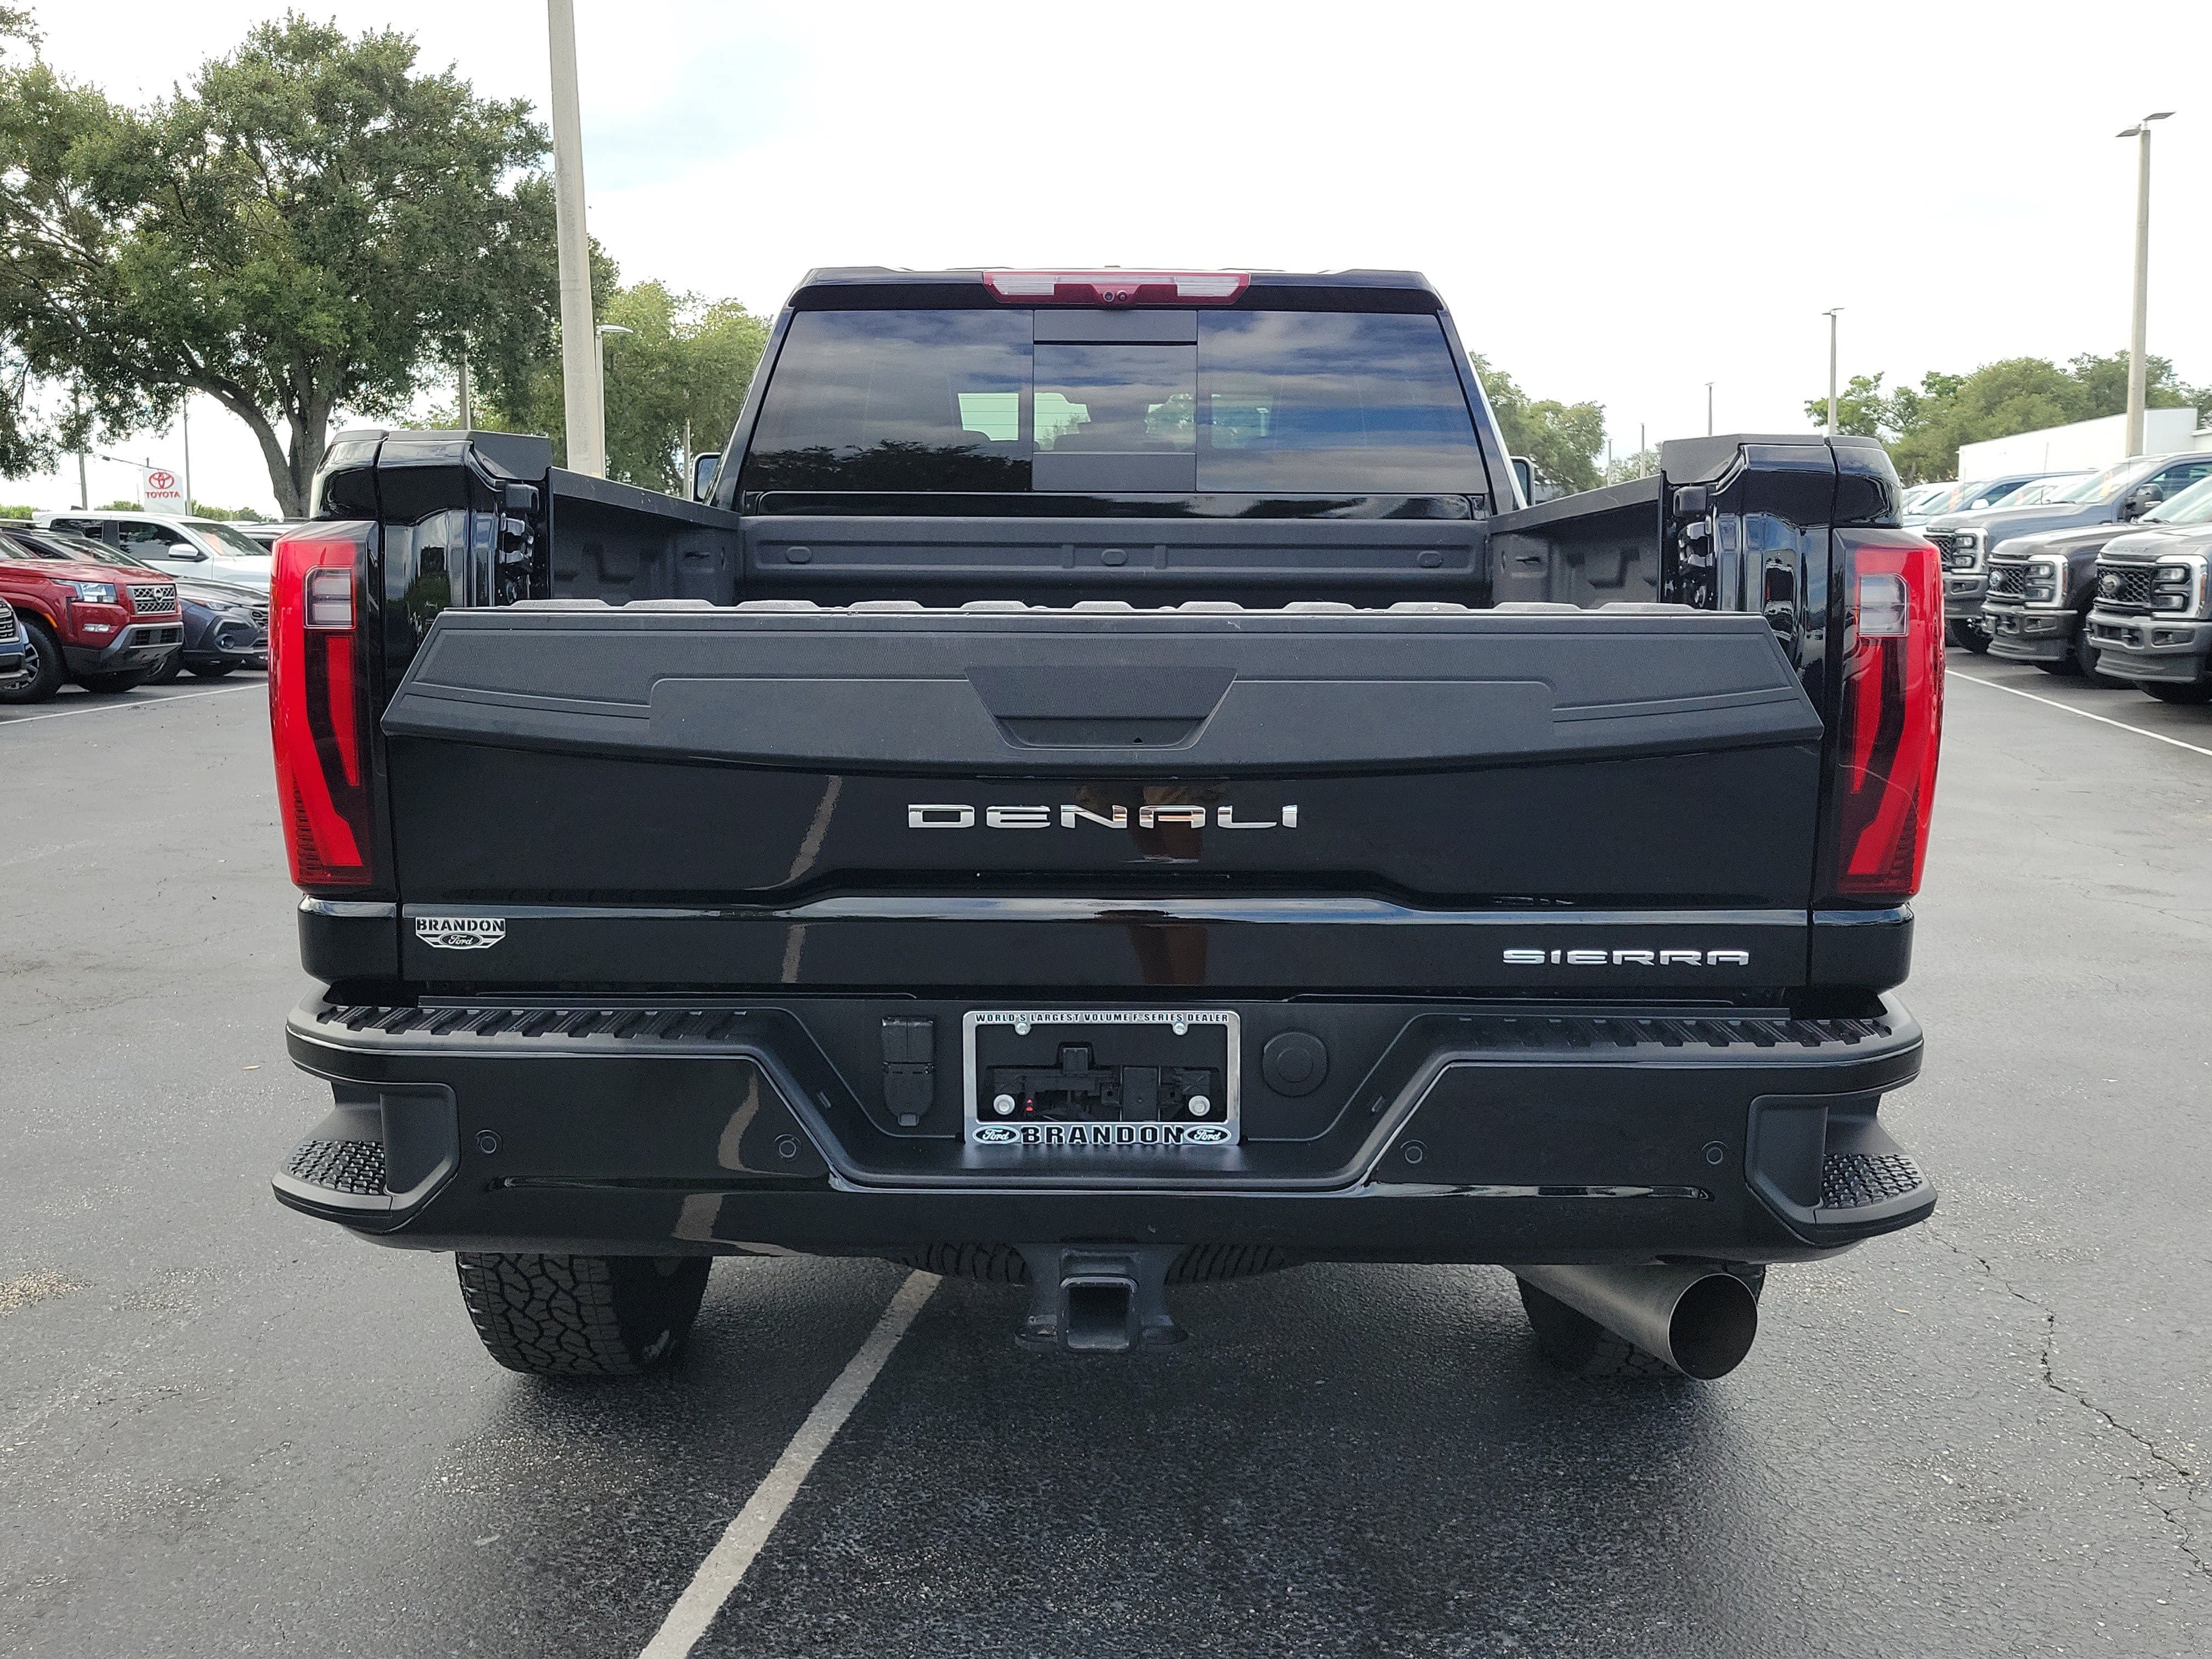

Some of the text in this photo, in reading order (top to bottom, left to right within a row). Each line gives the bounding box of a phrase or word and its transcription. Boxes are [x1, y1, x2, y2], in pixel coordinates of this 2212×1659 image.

[909, 804, 1297, 829] DENALI
[416, 918, 505, 932] BRANDON
[448, 935, 474, 945] Ford
[1503, 949, 1750, 966] SIERRA
[975, 1013, 1228, 1022] WORLD'S LARGEST VOLUME F-SERIES DEALER
[981, 1125, 1222, 1144] Ford BRANDON Ford
